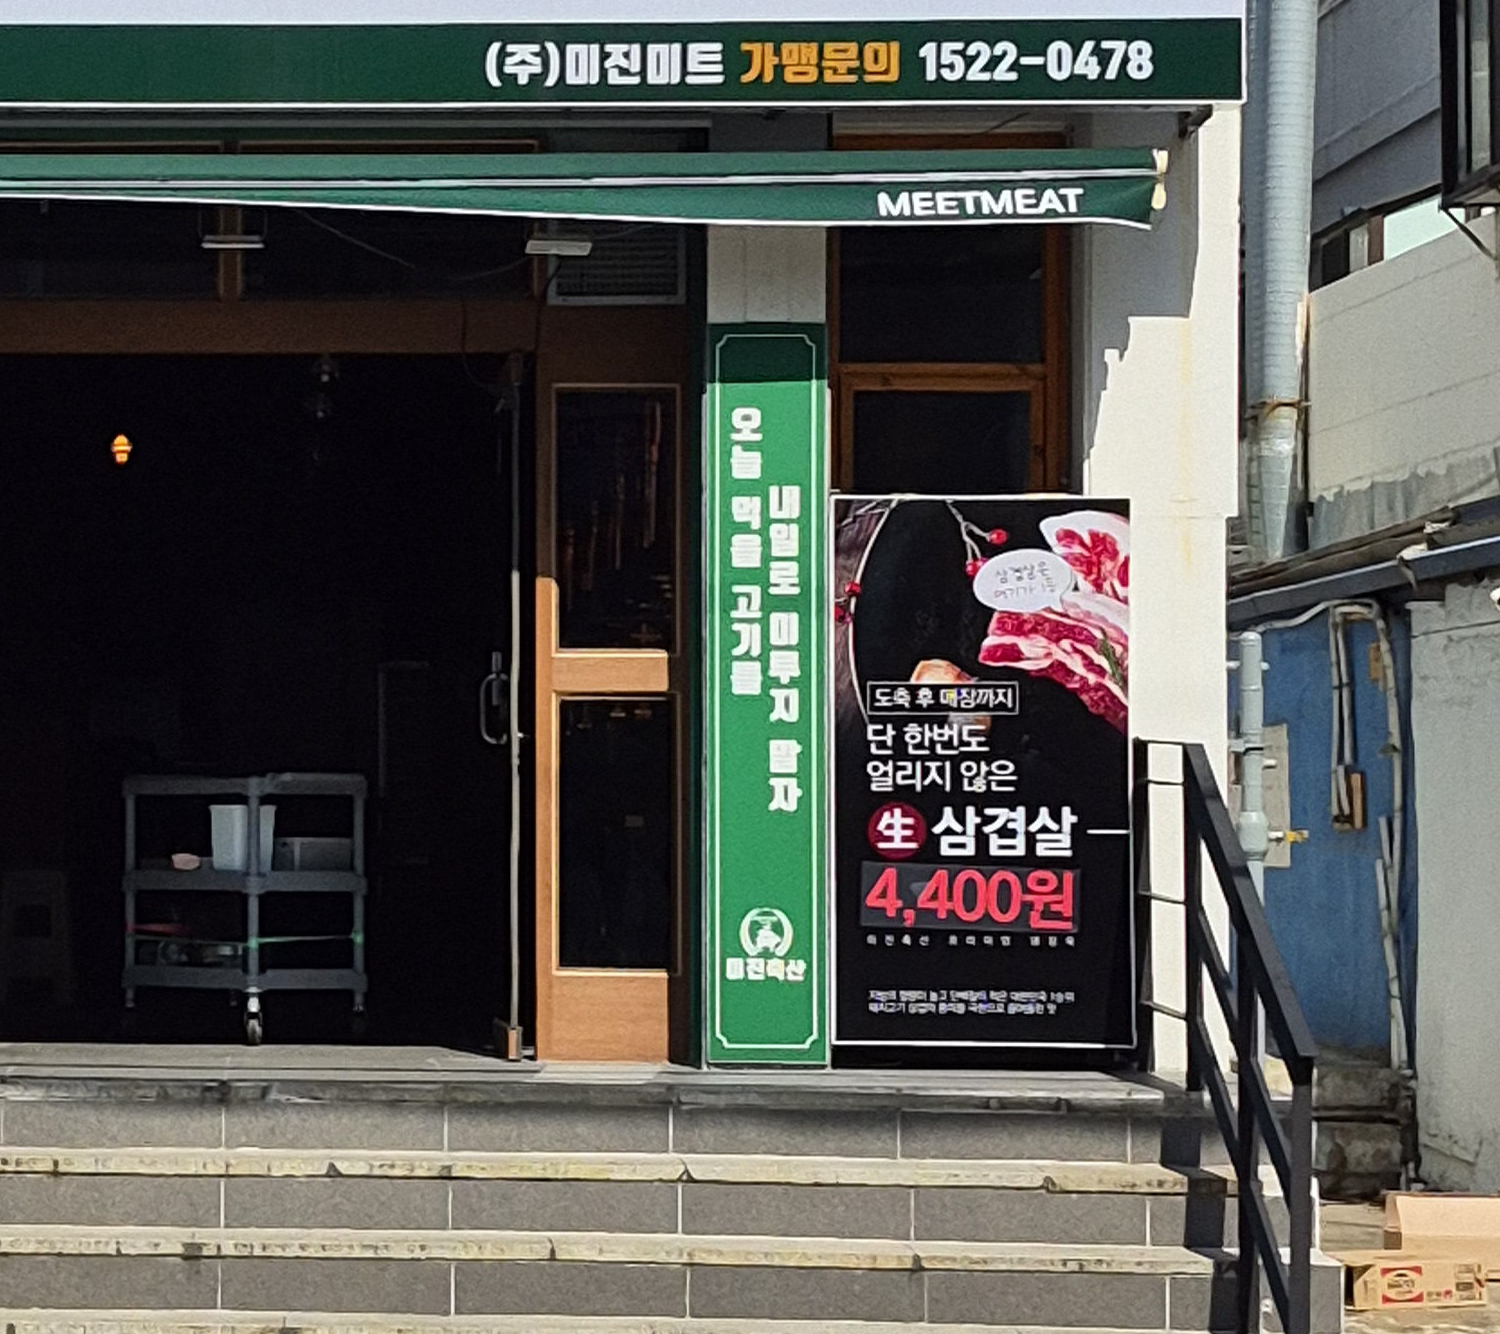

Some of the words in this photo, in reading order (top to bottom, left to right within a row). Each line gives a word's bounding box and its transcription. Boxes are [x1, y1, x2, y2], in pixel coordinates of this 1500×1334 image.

[485, 40, 726, 88] (주)미진미트
[740, 41, 901, 85] 가맹문의
[918, 39, 1155, 82] 1522-0478
[876, 187, 1085, 218] MEETMEAT
[730, 407, 763, 480] 오늘
[730, 496, 763, 568] 먹을
[768, 485, 801, 596] 내일로
[730, 584, 763, 696] 고기를
[768, 611, 801, 723] 미루지
[873, 688, 911, 709] 도축
[914, 687, 935, 709] 후
[940, 687, 1014, 709] 매장까지
[867, 723, 896, 755] 단
[902, 723, 991, 755] 한번도
[767, 739, 803, 812] 말자
[866, 760, 951, 793] 얼리지
[959, 760, 1018, 794] 않은
[876, 808, 920, 850] 生
[931, 805, 1079, 858] 삼겹살
[865, 867, 1075, 932] 4,400원
[726, 957, 807, 982] 미진축산
